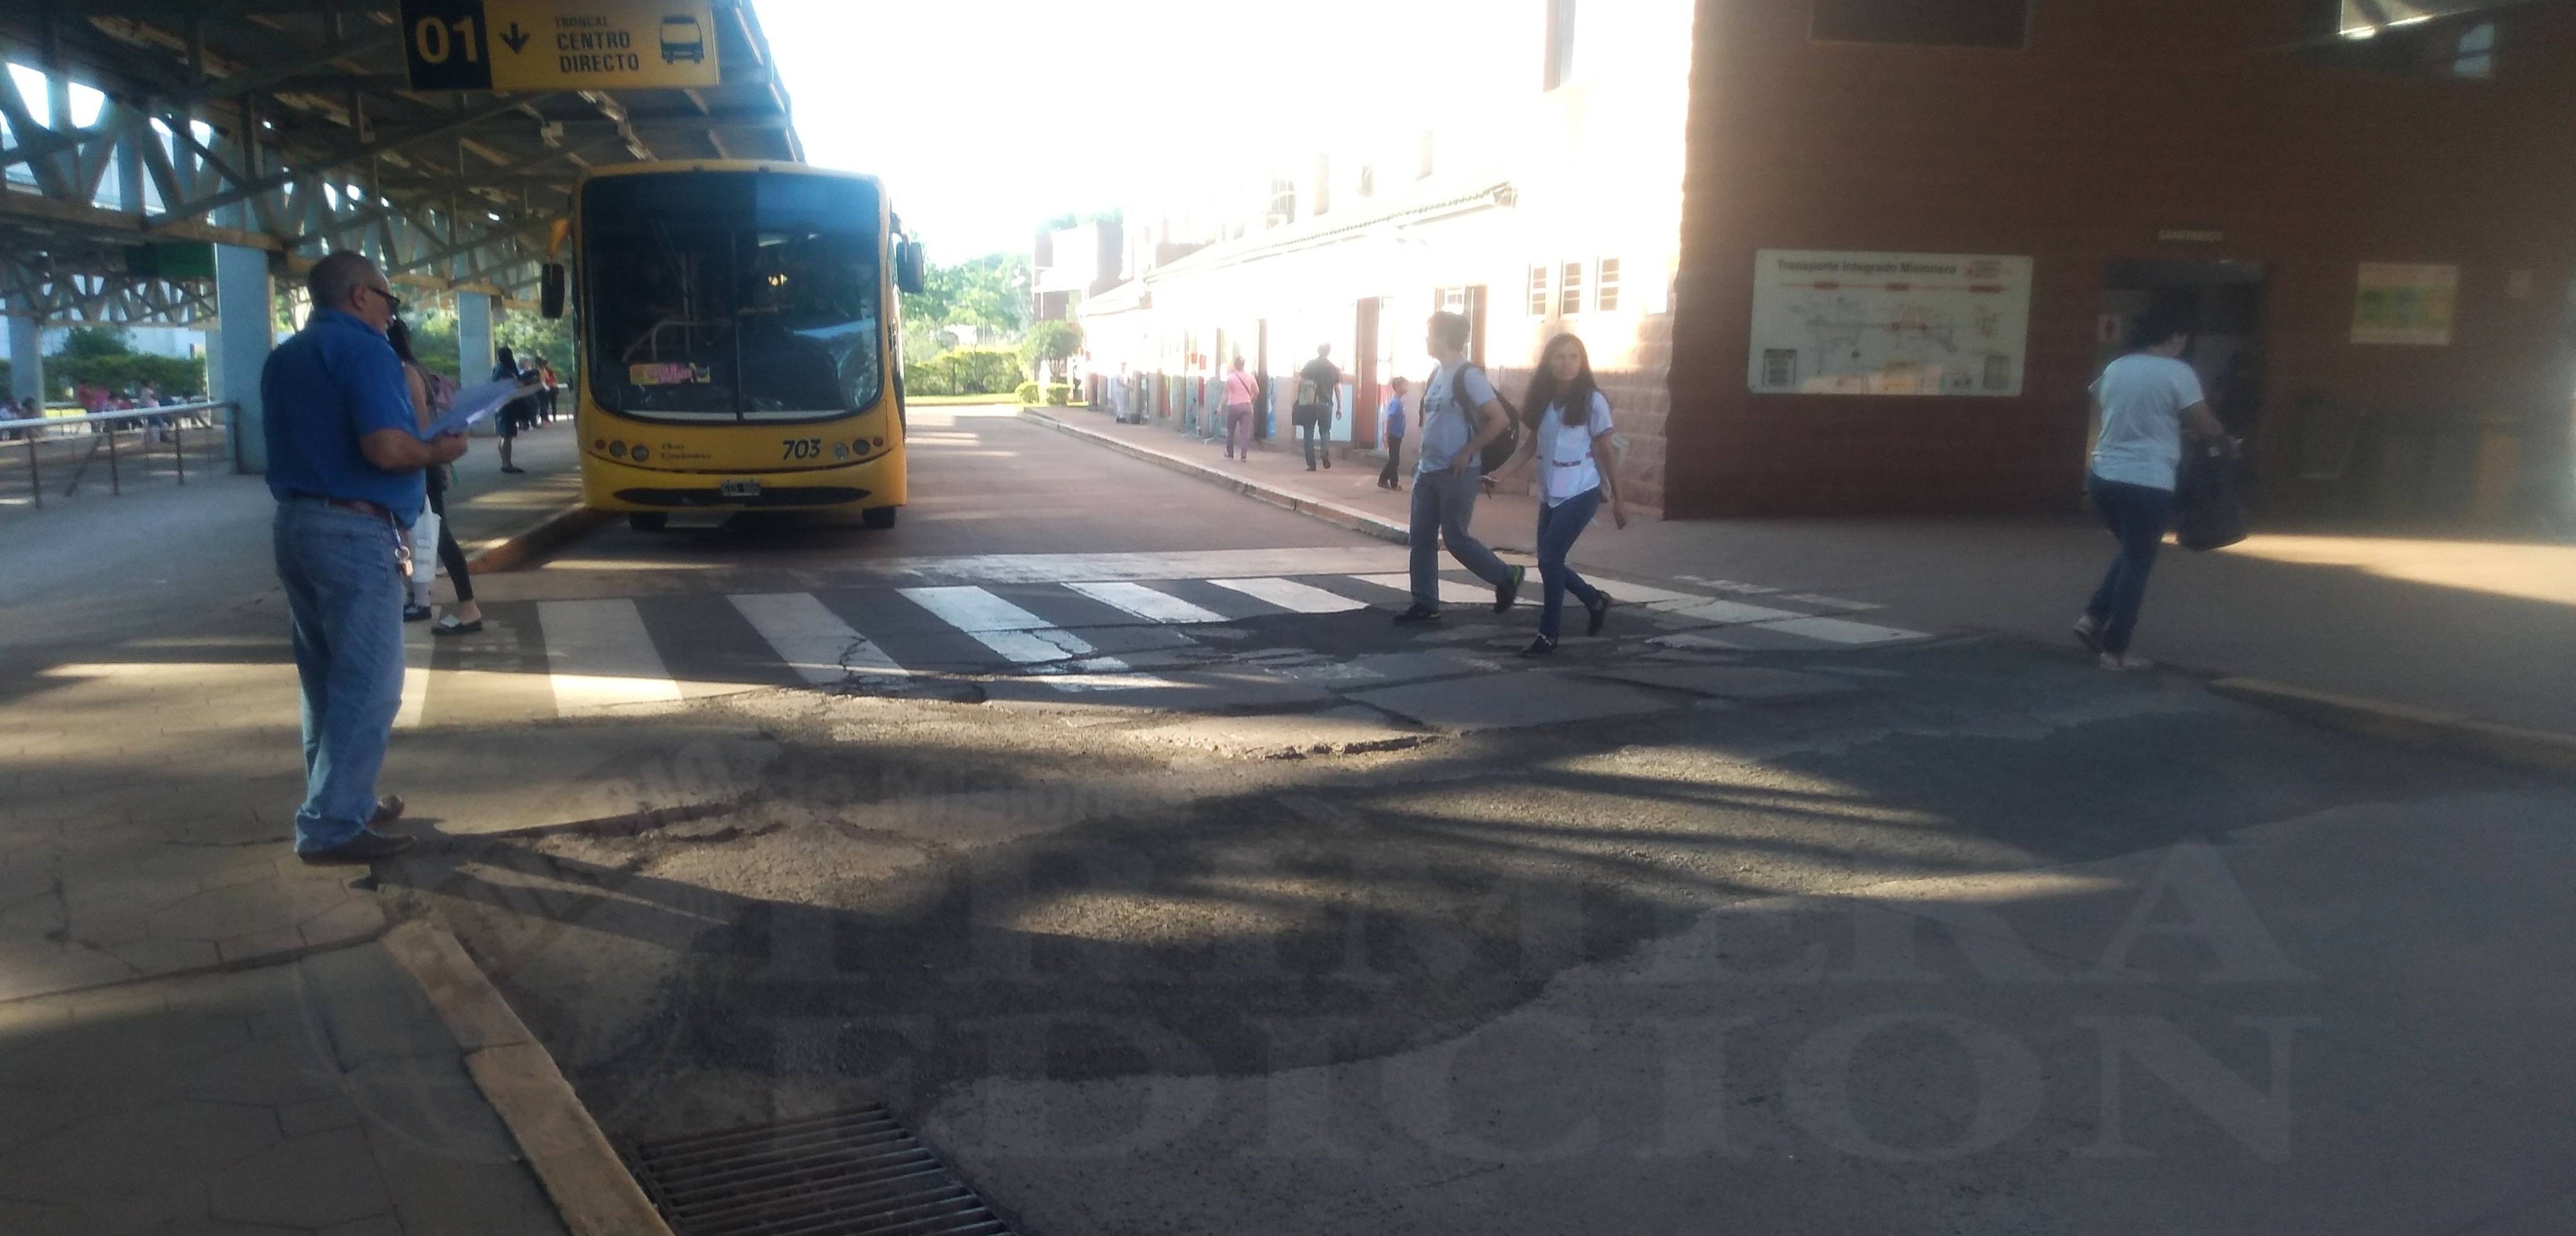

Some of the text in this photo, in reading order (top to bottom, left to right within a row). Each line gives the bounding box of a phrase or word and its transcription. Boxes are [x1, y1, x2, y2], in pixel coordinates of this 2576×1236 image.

[415, 15, 478, 64] 01
[556, 30, 631, 52] CENTRO
[559, 52, 639, 73] DIRECTO
[1777, 258, 1839, 273] Transporte
[1900, 261, 1957, 274] Misionero
[782, 439, 821, 460] 703
